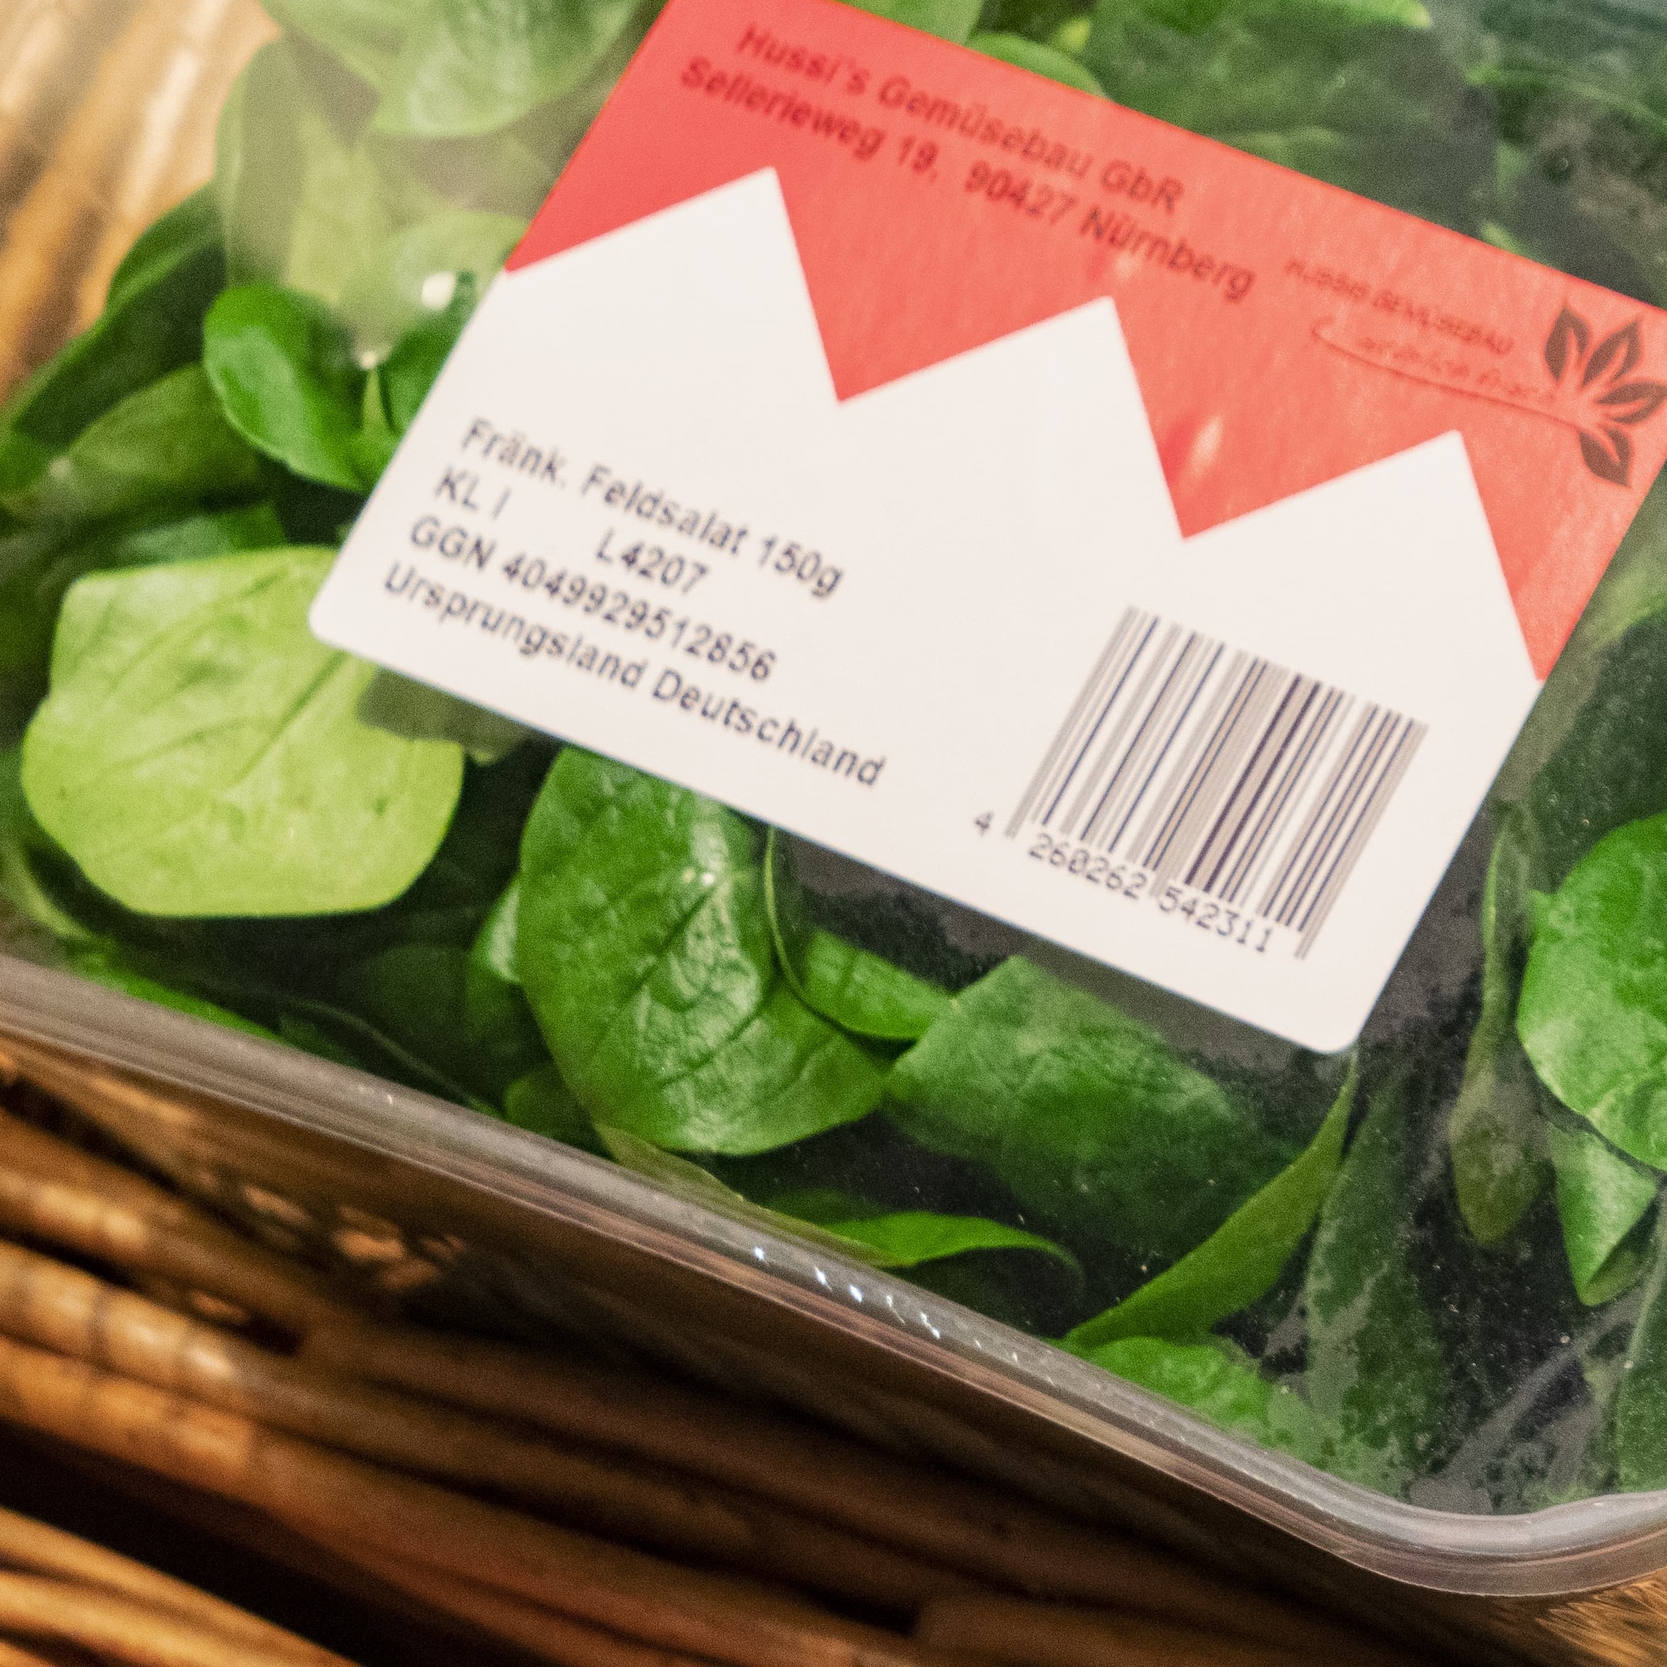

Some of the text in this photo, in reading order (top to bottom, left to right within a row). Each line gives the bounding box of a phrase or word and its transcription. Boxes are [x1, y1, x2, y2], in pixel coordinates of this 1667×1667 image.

[680, 56, 886, 161] Sellerieweg
[964, 159, 1078, 226] 90427
[1080, 204, 1258, 303] Nürnberg
[735, 23, 1185, 214] Hussi's Gemüsebau GbR
[410, 514, 778, 683] GGN 4049929512856
[435, 465, 478, 511] KL
[595, 528, 710, 596] L4207
[461, 417, 844, 600] Fränk. Feldsalat 150g
[383, 561, 886, 788] Ursprungsland Deutschland
[1028, 832, 1148, 900] 260262
[1158, 885, 1273, 954] 542311
